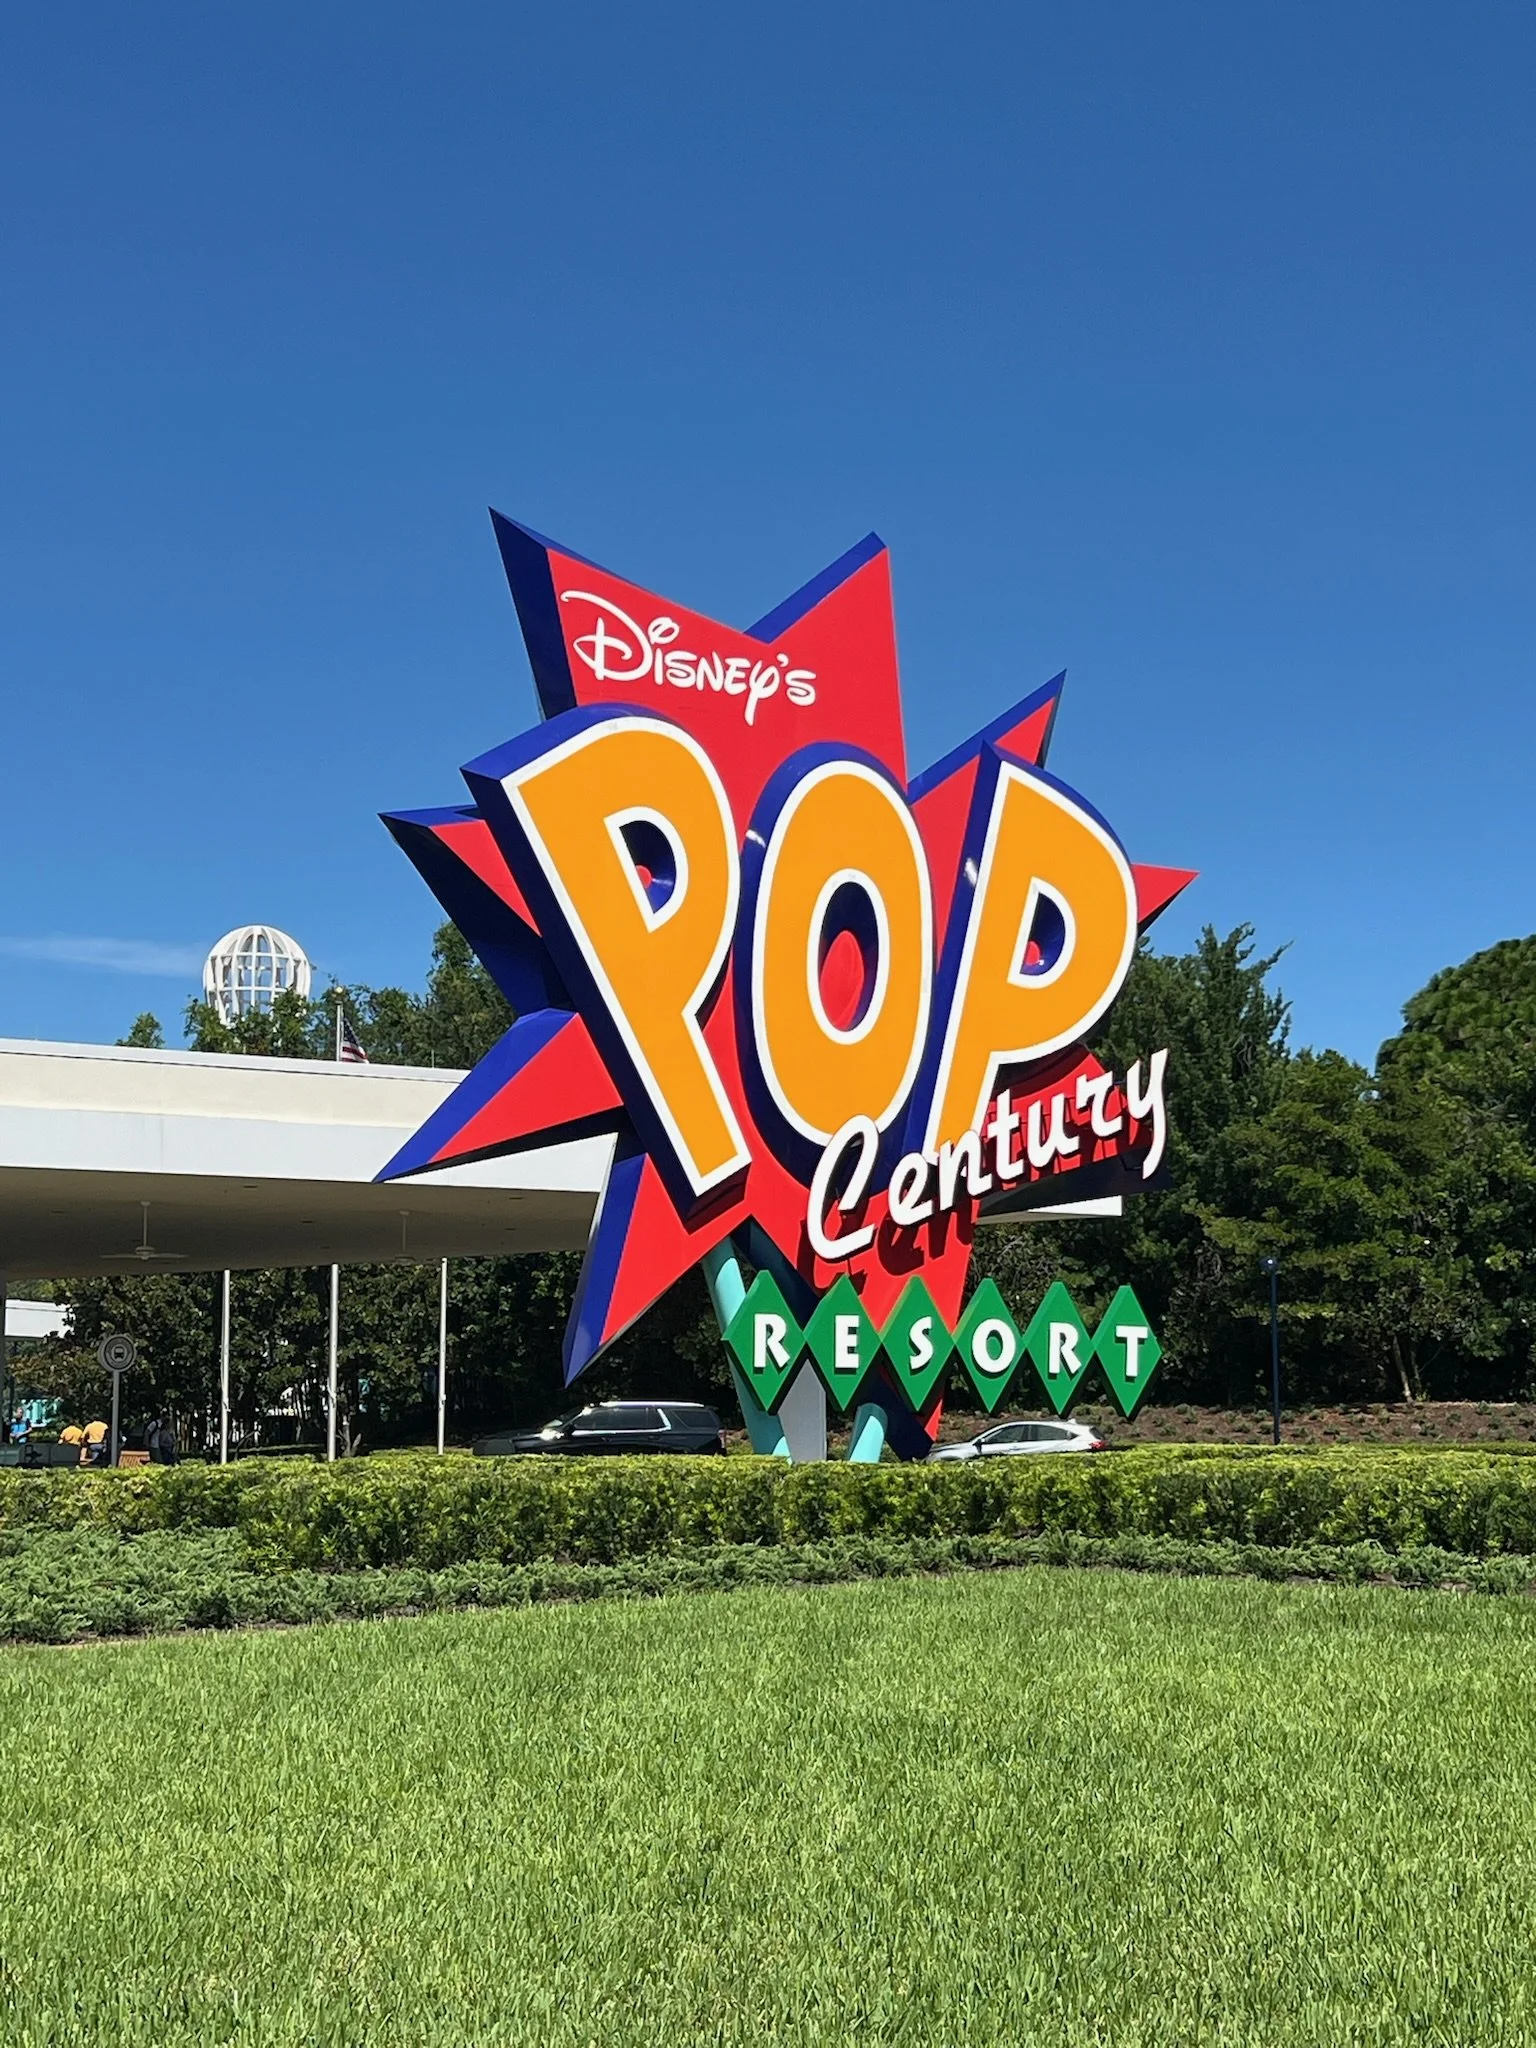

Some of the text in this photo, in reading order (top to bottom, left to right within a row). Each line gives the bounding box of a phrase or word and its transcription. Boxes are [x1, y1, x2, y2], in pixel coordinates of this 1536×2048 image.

[500, 715, 1139, 1198] POP
[806, 1048, 1168, 1260] Century
[753, 1313, 1149, 1378] RESORT
